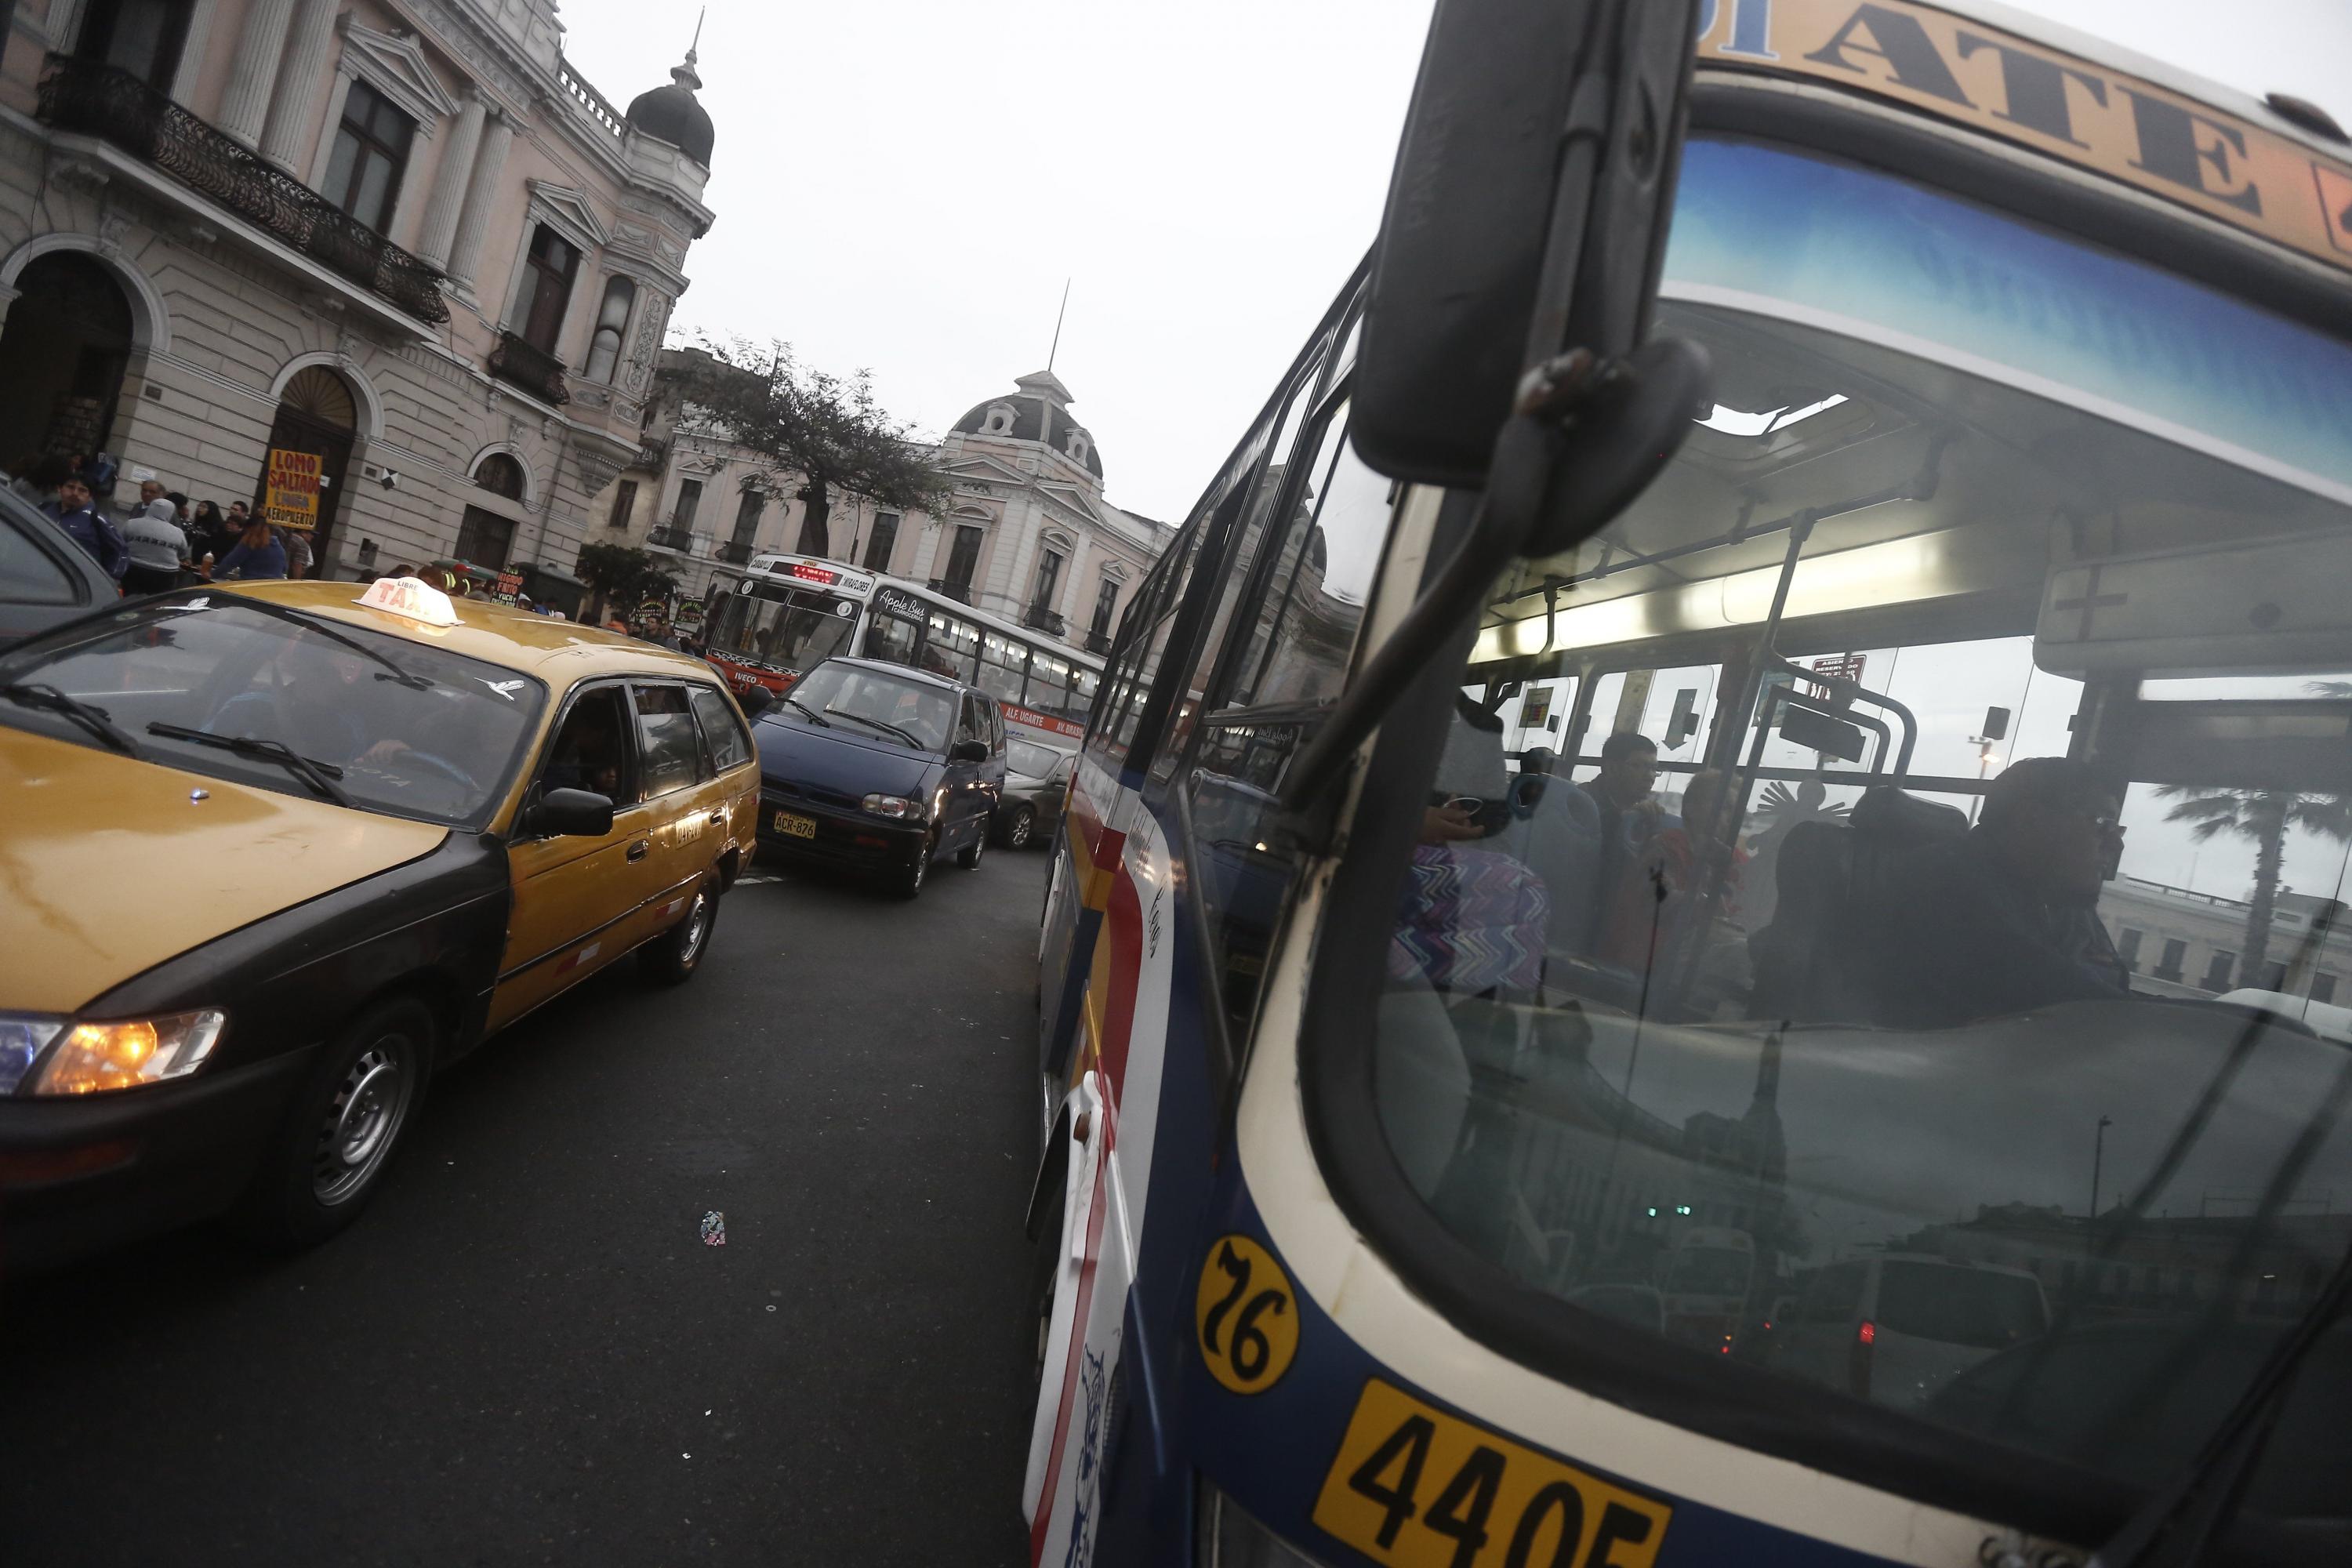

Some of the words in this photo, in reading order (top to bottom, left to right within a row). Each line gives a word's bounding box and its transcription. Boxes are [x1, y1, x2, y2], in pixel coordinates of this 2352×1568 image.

[1803, 2, 2263, 218] ATE
[275, 451, 317, 473] LOMO
[268, 470, 320, 495] SALTADO
[267, 506, 314, 525] AEROPUERTO
[397, 581, 419, 591] LIBRE
[379, 583, 430, 615] TAX
[879, 590, 907, 612] Apple
[908, 600, 925, 616] Bus
[893, 607, 924, 622] CARROCERIAS
[734, 672, 757, 684] IVECO
[1005, 707, 1019, 720] ALF.
[1019, 711, 1044, 727] UGARTE
[1056, 721, 1065, 733] AV.
[775, 816, 814, 837] ACR-876
[1203, 1239, 1287, 1381] 76
